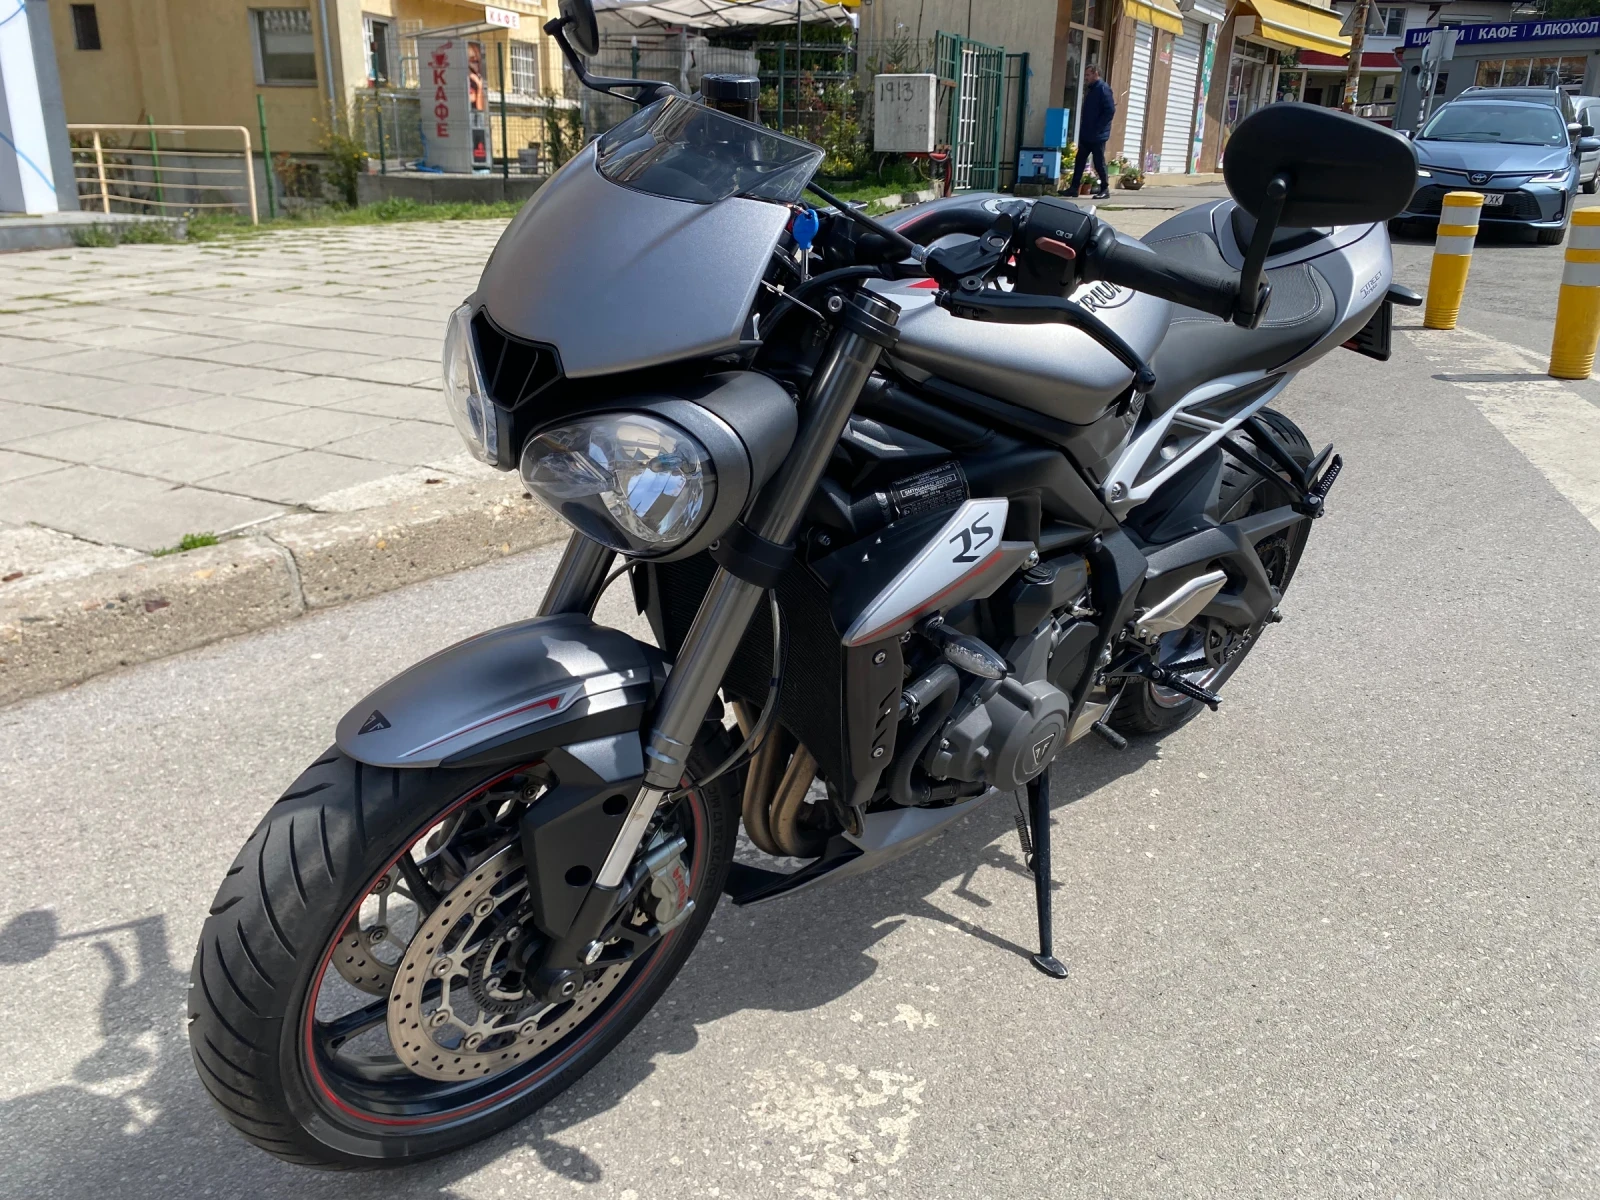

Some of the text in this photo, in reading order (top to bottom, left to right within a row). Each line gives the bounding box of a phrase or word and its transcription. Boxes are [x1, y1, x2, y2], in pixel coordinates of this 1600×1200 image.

[490, 11, 517, 27] КАФЕ
[1478, 26, 1518, 39] КАФЕ
[1532, 21, 1599, 36] АЛКОХОЛ
[880, 81, 914, 104] 1913
[433, 69, 449, 138] КАФЕ
